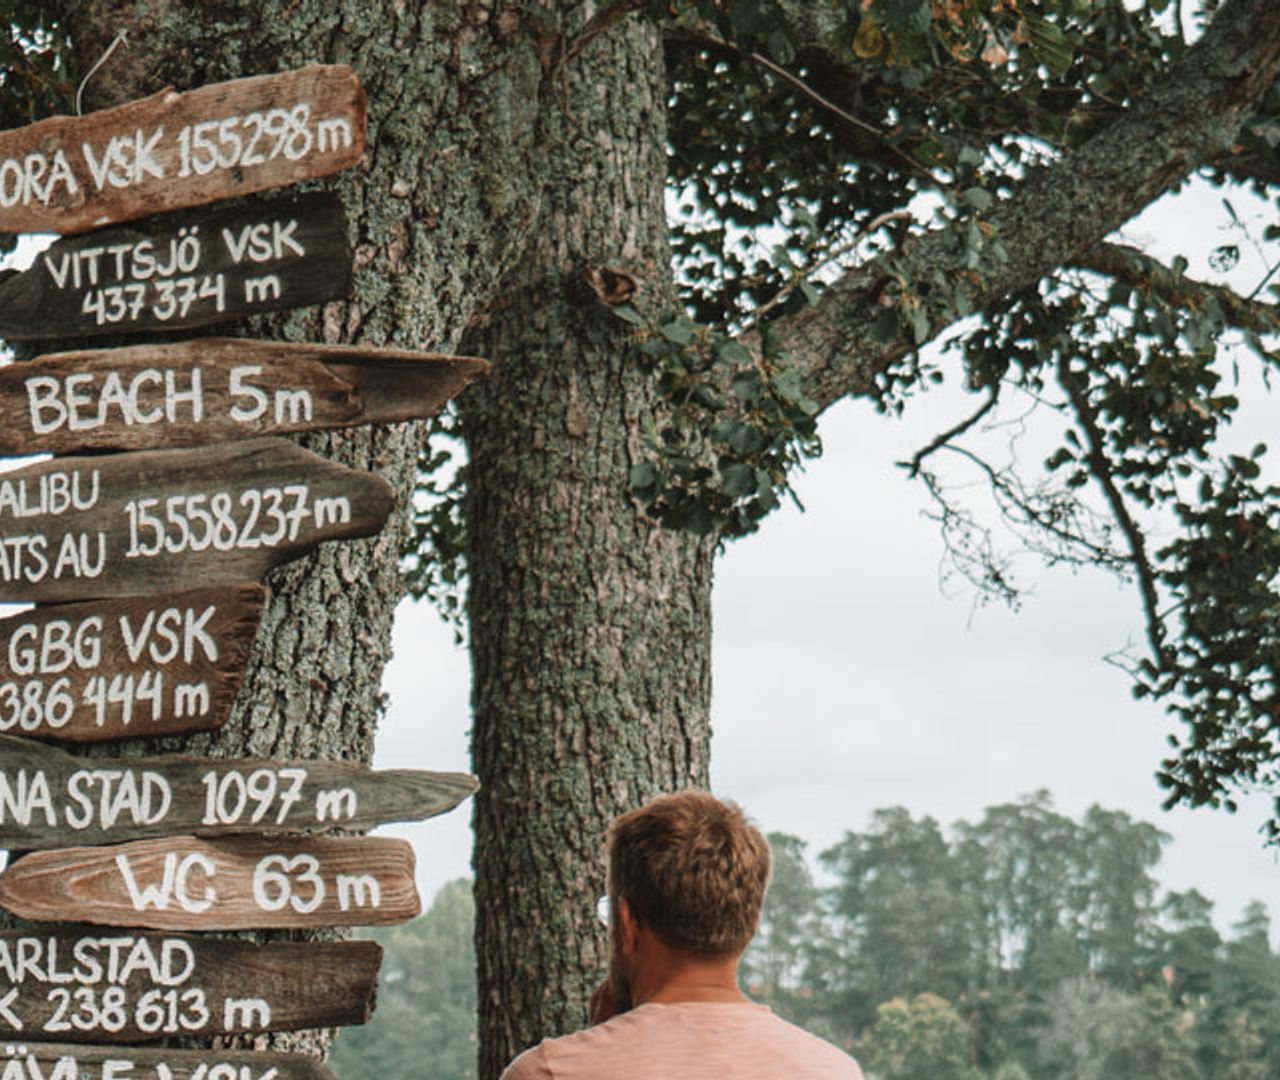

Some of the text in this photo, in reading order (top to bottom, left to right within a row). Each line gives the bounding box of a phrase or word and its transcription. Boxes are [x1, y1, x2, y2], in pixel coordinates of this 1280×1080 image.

[83, 127, 166, 191] VSK
[44, 219, 305, 288] VITTSJÖ VSK
[244, 274, 281, 303] m
[25, 367, 203, 434] BEACH
[53, 531, 107, 579] AU
[8, 605, 218, 675] GBG VSK
[174, 683, 210, 718] m
[65, 768, 172, 830] STAD
[202, 768, 308, 826] 1097
[116, 853, 381, 913] WC 63 m
[223, 996, 272, 1031] m
